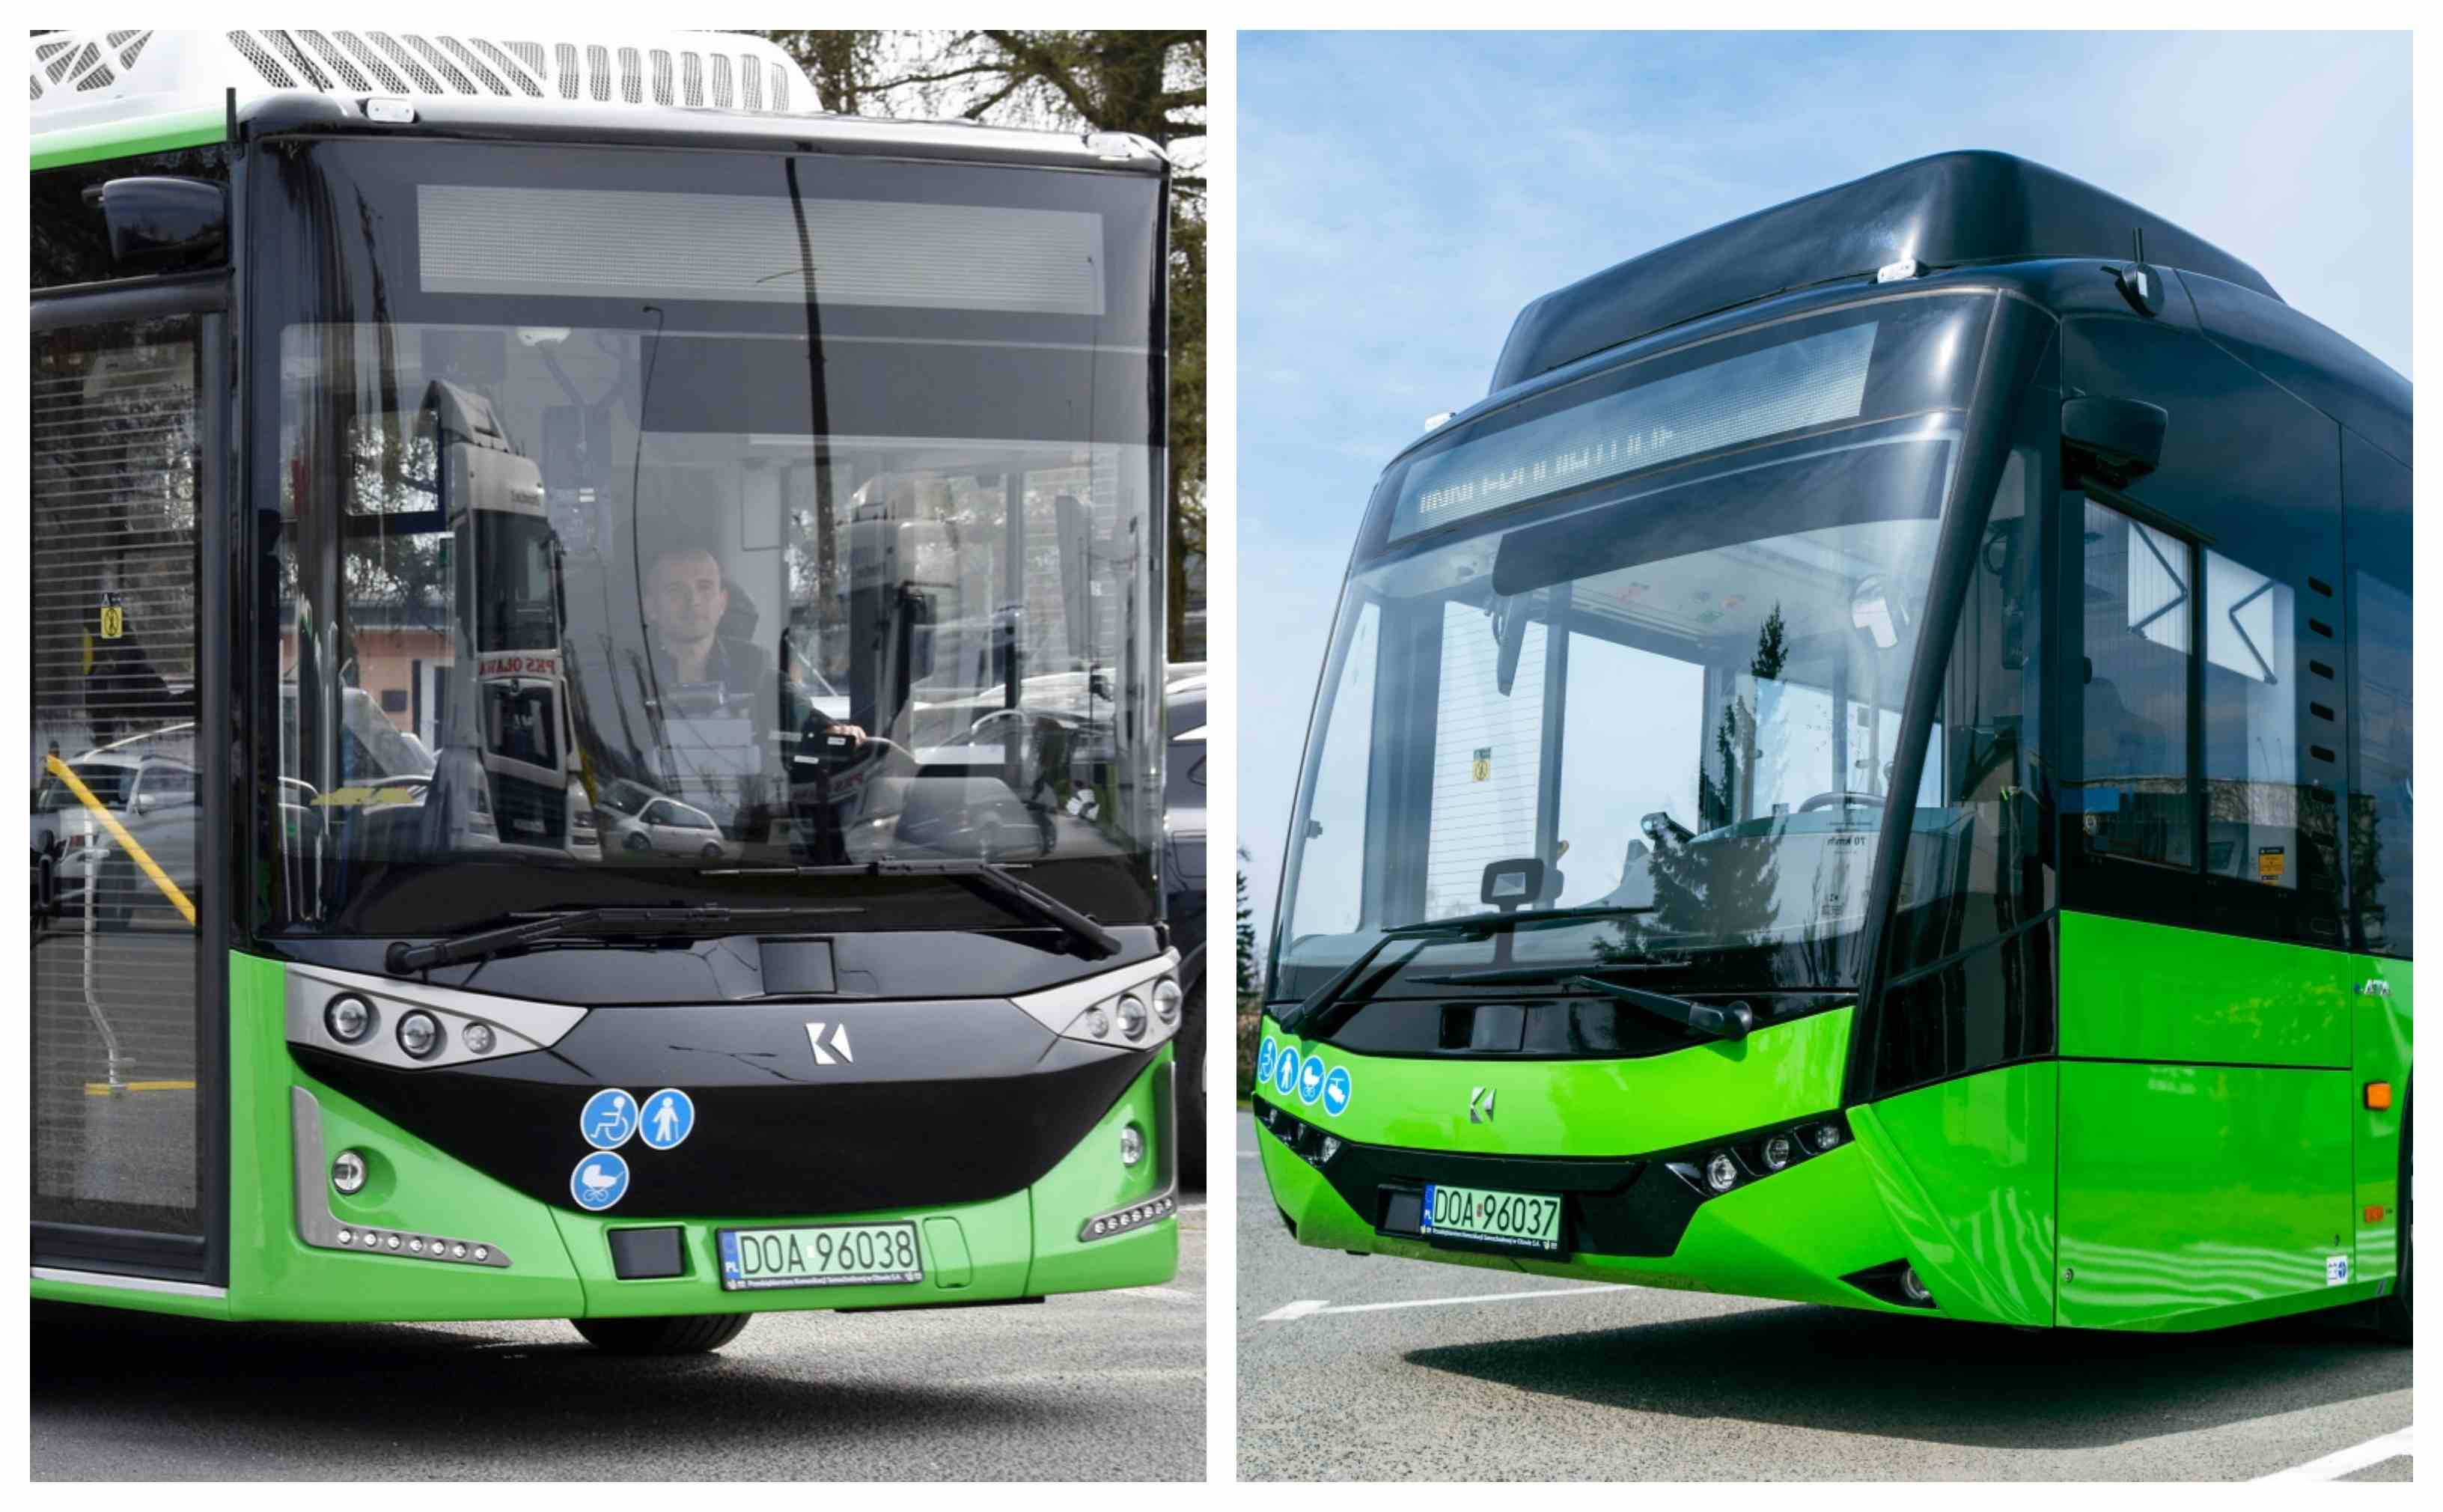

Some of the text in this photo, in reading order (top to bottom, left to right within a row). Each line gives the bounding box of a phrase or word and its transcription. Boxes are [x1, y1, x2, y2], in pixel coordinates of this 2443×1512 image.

[1434, 1189, 1558, 1237] DOA 96037
[725, 1262, 739, 1273] PL
[739, 1230, 915, 1274] DOA 96038
